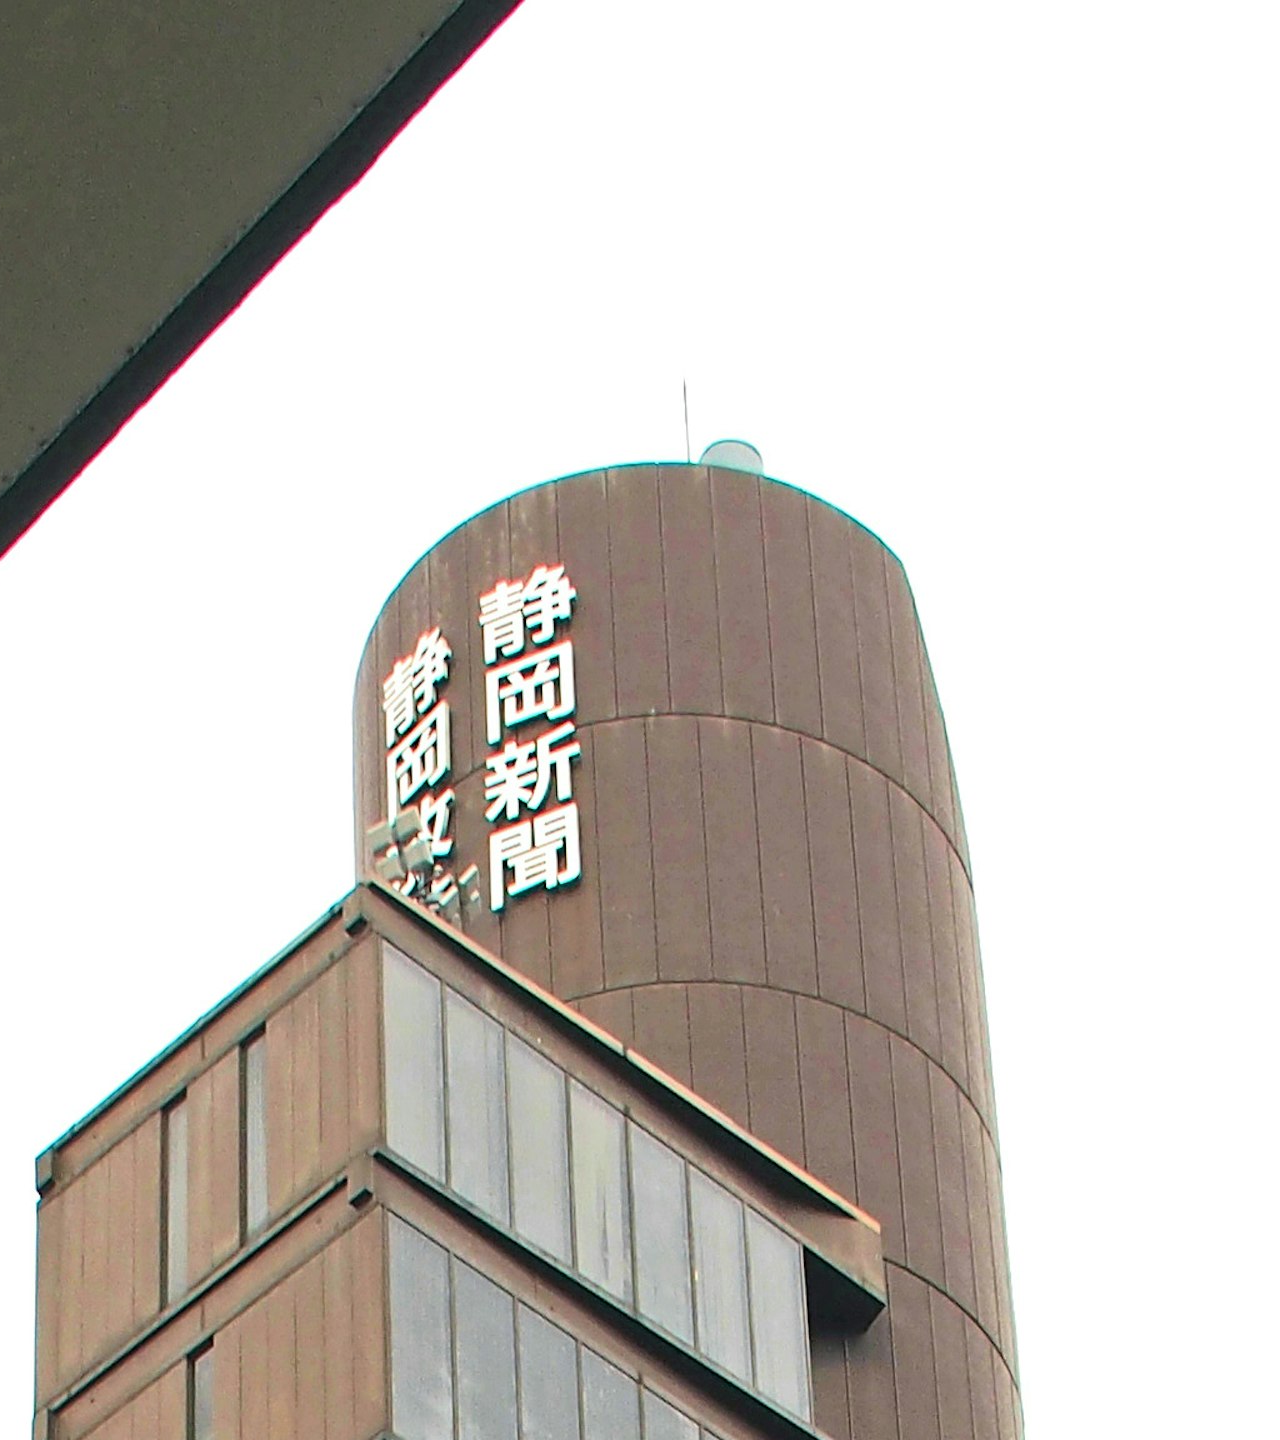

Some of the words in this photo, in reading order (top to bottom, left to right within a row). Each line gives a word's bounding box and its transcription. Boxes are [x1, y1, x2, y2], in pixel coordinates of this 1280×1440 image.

[383, 626, 455, 898] 静岡
[479, 564, 581, 911] 静岡新聞
